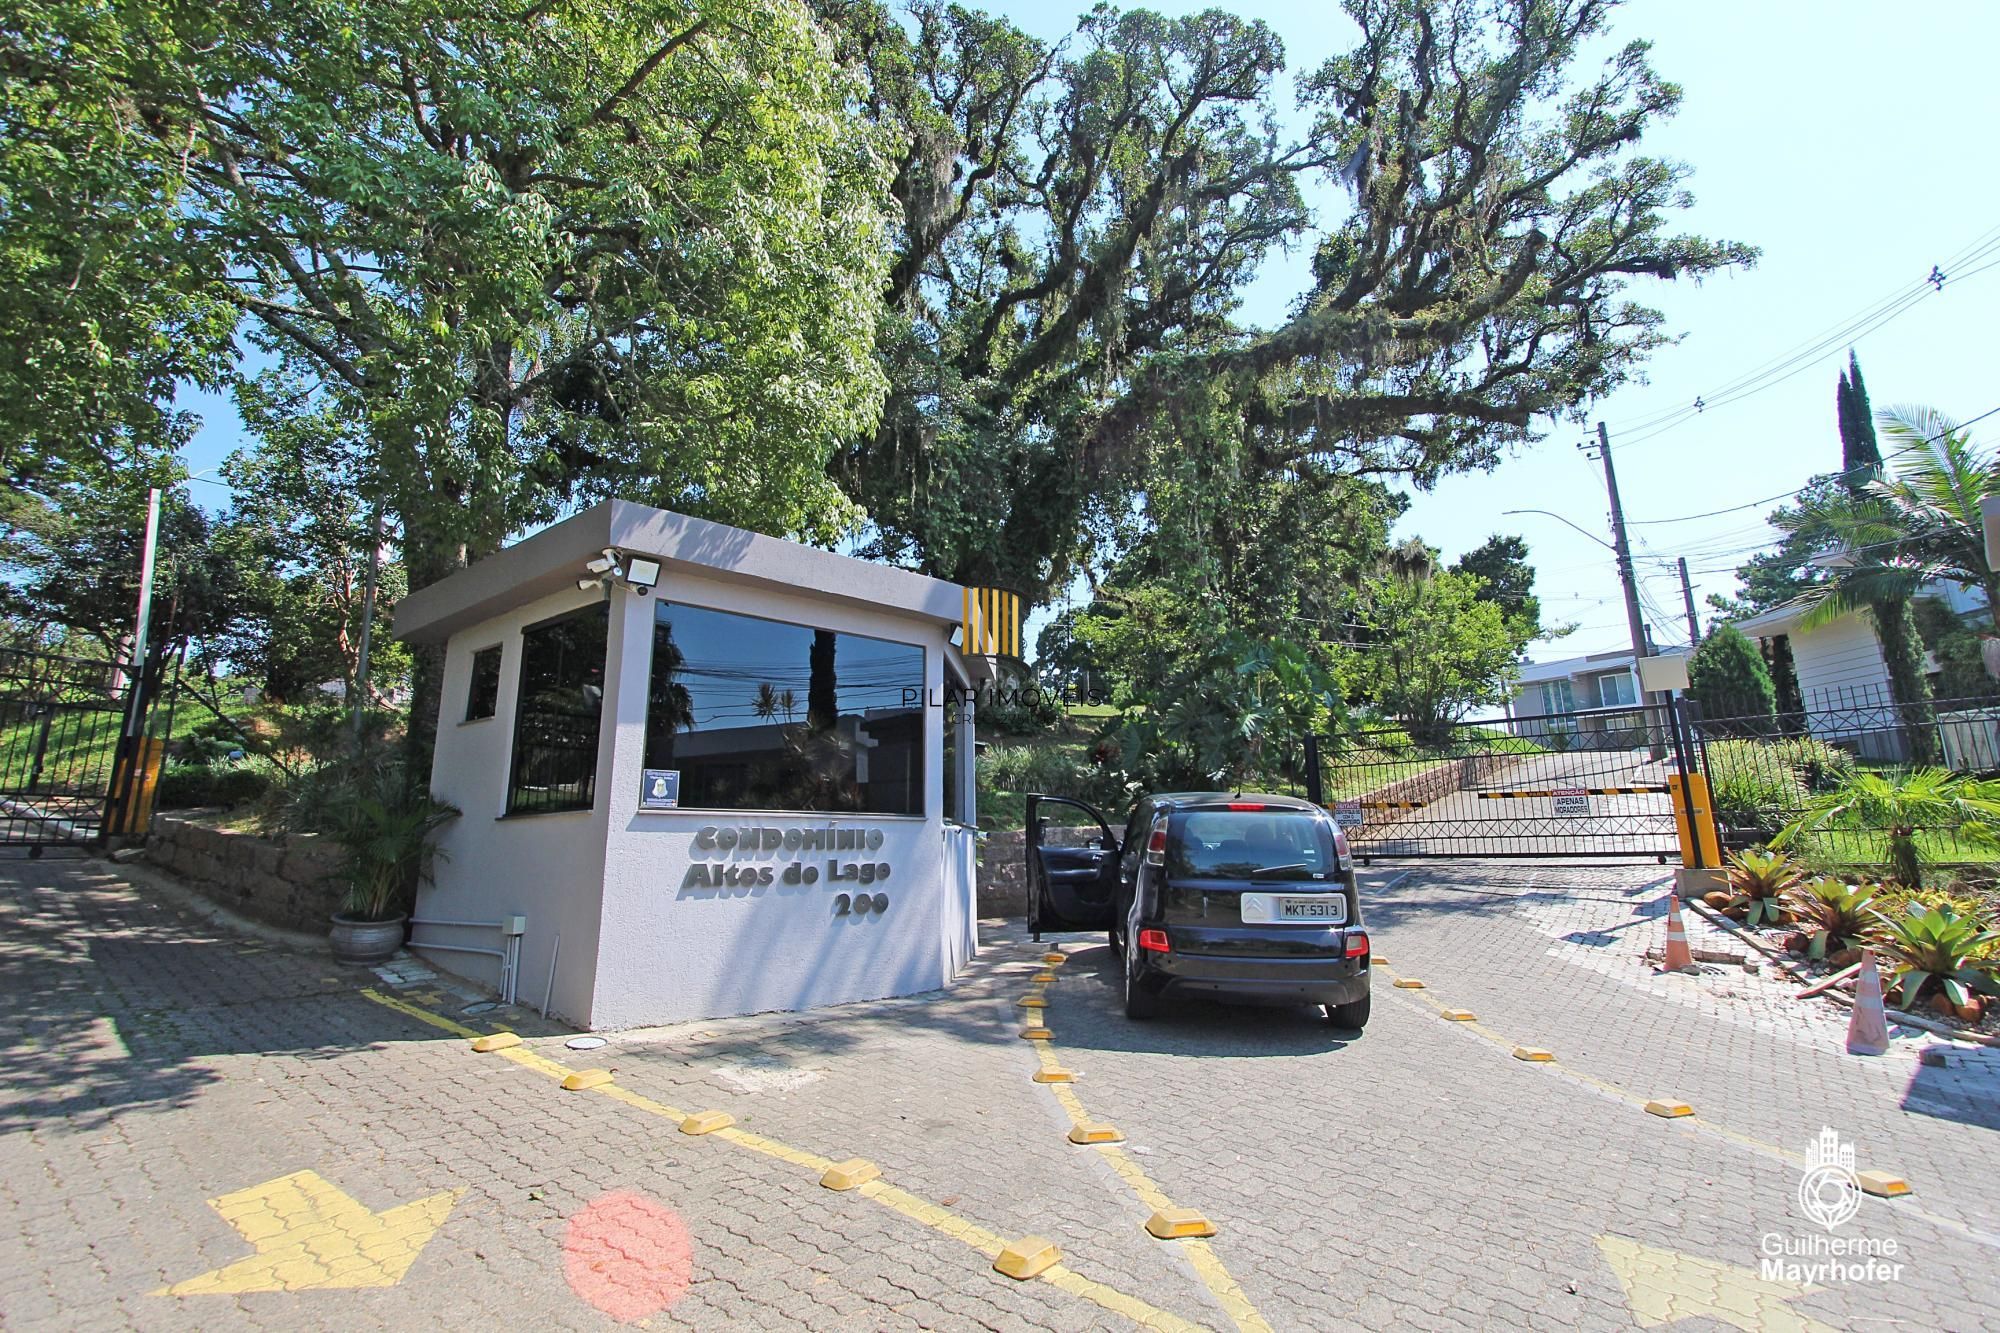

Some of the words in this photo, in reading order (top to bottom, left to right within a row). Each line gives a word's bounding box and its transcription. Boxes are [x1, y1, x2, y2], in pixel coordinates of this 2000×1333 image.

[1554, 805, 1588, 814] MORADORES
[1556, 797, 1584, 805] APENAS
[696, 820, 885, 850] CONDOMÍNIO
[683, 862, 775, 889] Altos
[782, 862, 819, 885] do
[827, 859, 891, 884] Lago
[835, 892, 890, 917] 200
